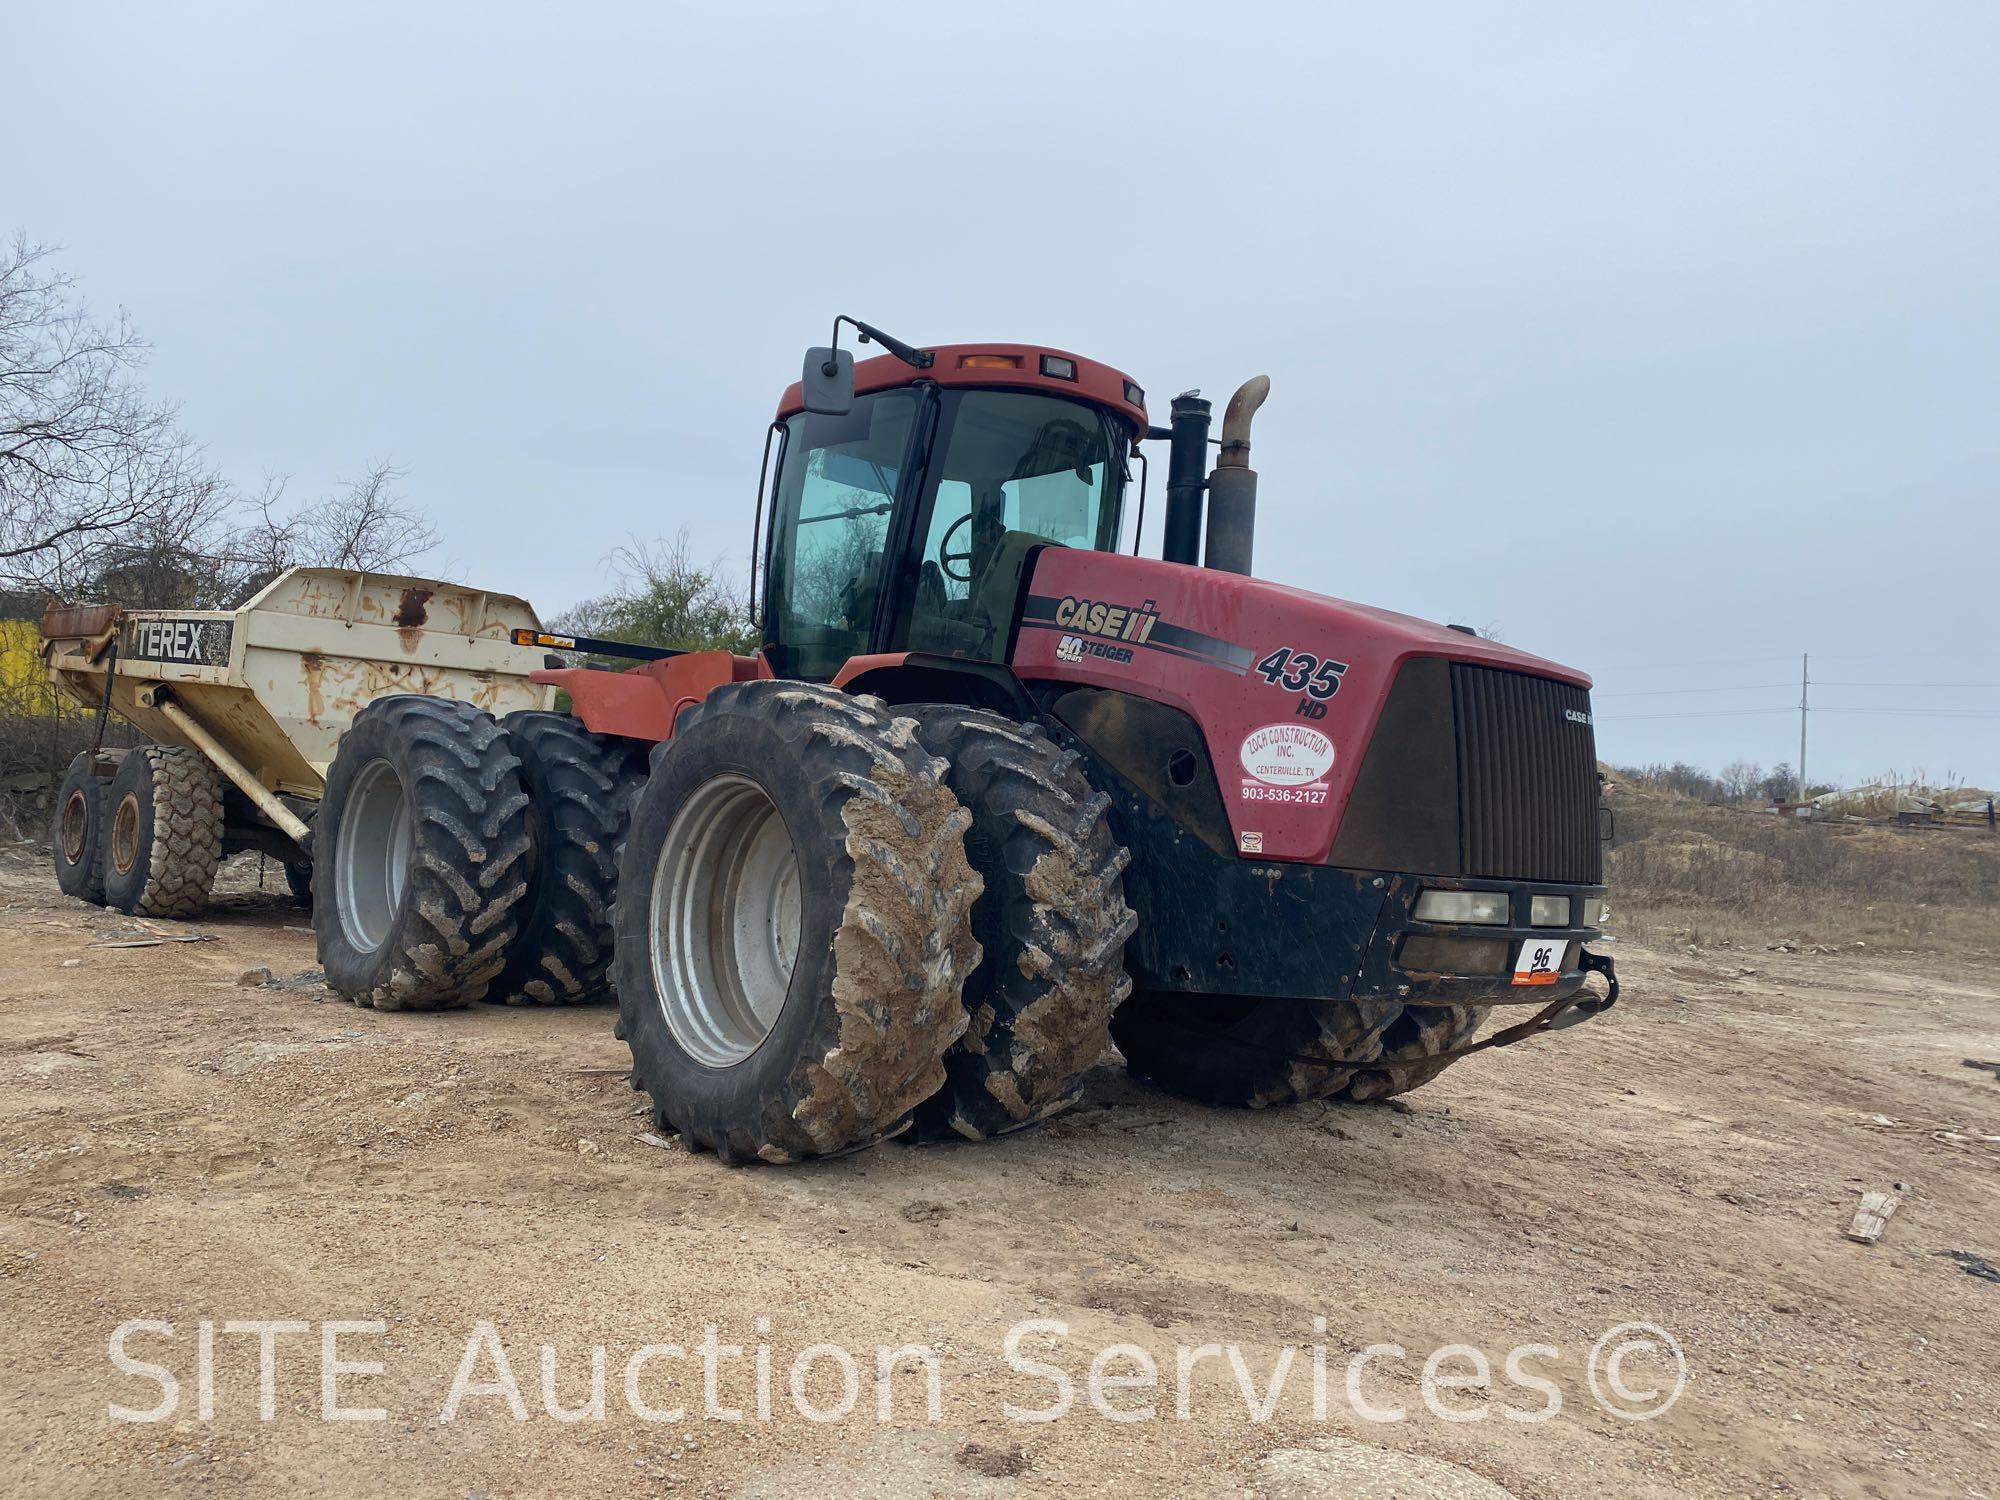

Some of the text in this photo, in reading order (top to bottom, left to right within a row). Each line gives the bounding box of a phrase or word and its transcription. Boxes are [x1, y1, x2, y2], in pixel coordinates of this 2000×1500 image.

[1056, 598, 1127, 637] CASE
[138, 622, 204, 660] TEREX
[1057, 635, 1134, 664] 50 STEIGER
[1063, 652, 1083, 663] years
[1255, 646, 1348, 700] 435
[1295, 698, 1328, 720] HD
[1566, 709, 1587, 724] CASE
[1246, 727, 1329, 757] ZOCH CONSTRUCTION
[1277, 745, 1294, 758] INC.
[1305, 767, 1315, 776] TX
[1242, 787, 1327, 804] 903-536-2127
[1532, 947, 1552, 968] 96
